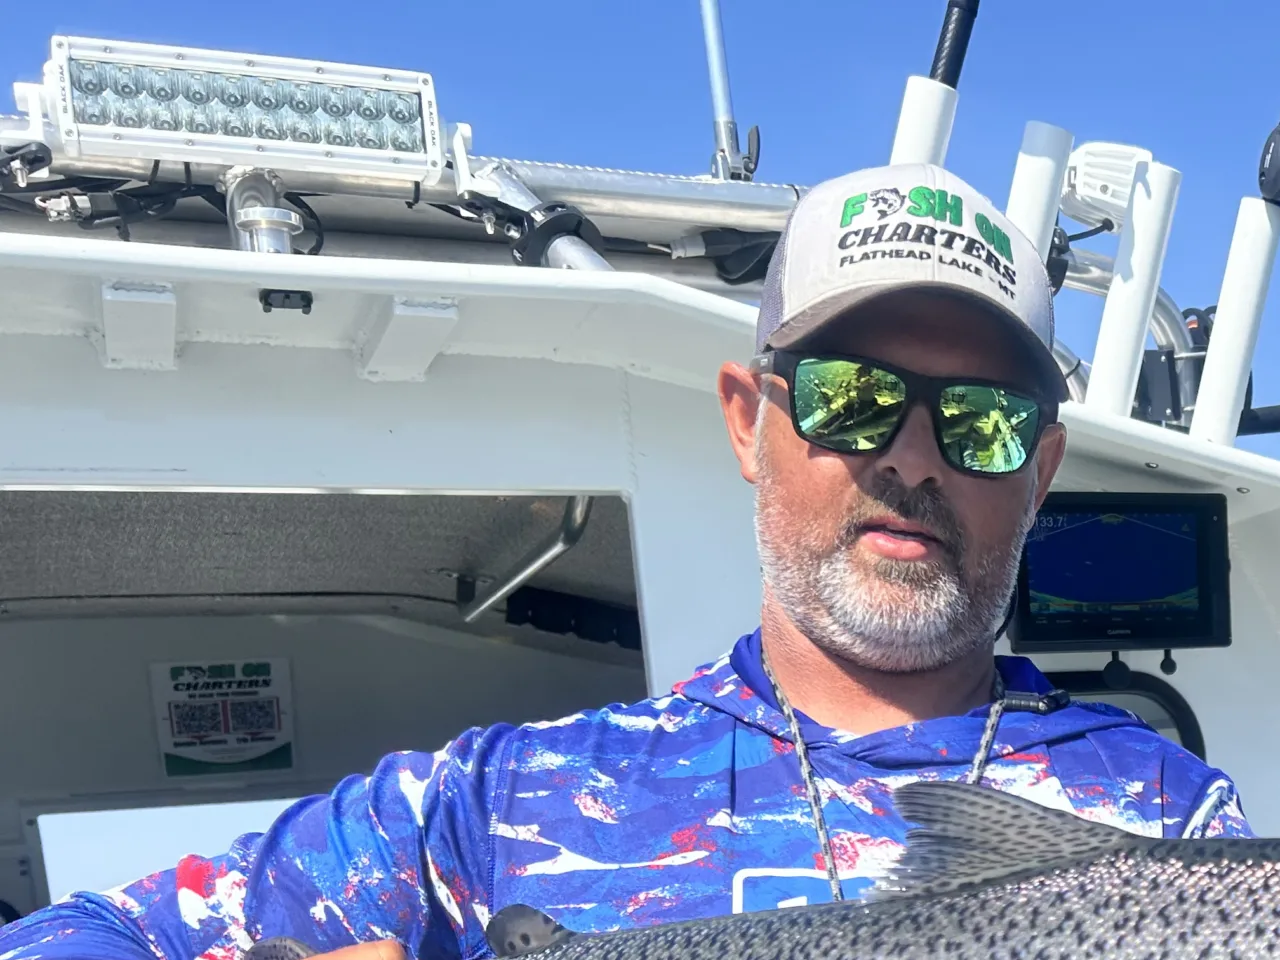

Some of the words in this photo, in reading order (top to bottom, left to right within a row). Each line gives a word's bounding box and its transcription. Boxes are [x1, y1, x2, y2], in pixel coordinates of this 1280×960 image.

[58, 64, 66, 82] OAK
[60, 86, 68, 114] BLACK
[427, 100, 435, 127] BLACK
[974, 212, 1014, 265] ON
[837, 221, 1017, 286] CHARTERS
[838, 248, 932, 268] FLATHEAD
[938, 254, 983, 278] LAKE
[998, 280, 1016, 300] MT
[173, 678, 272, 692] CHARTERS
